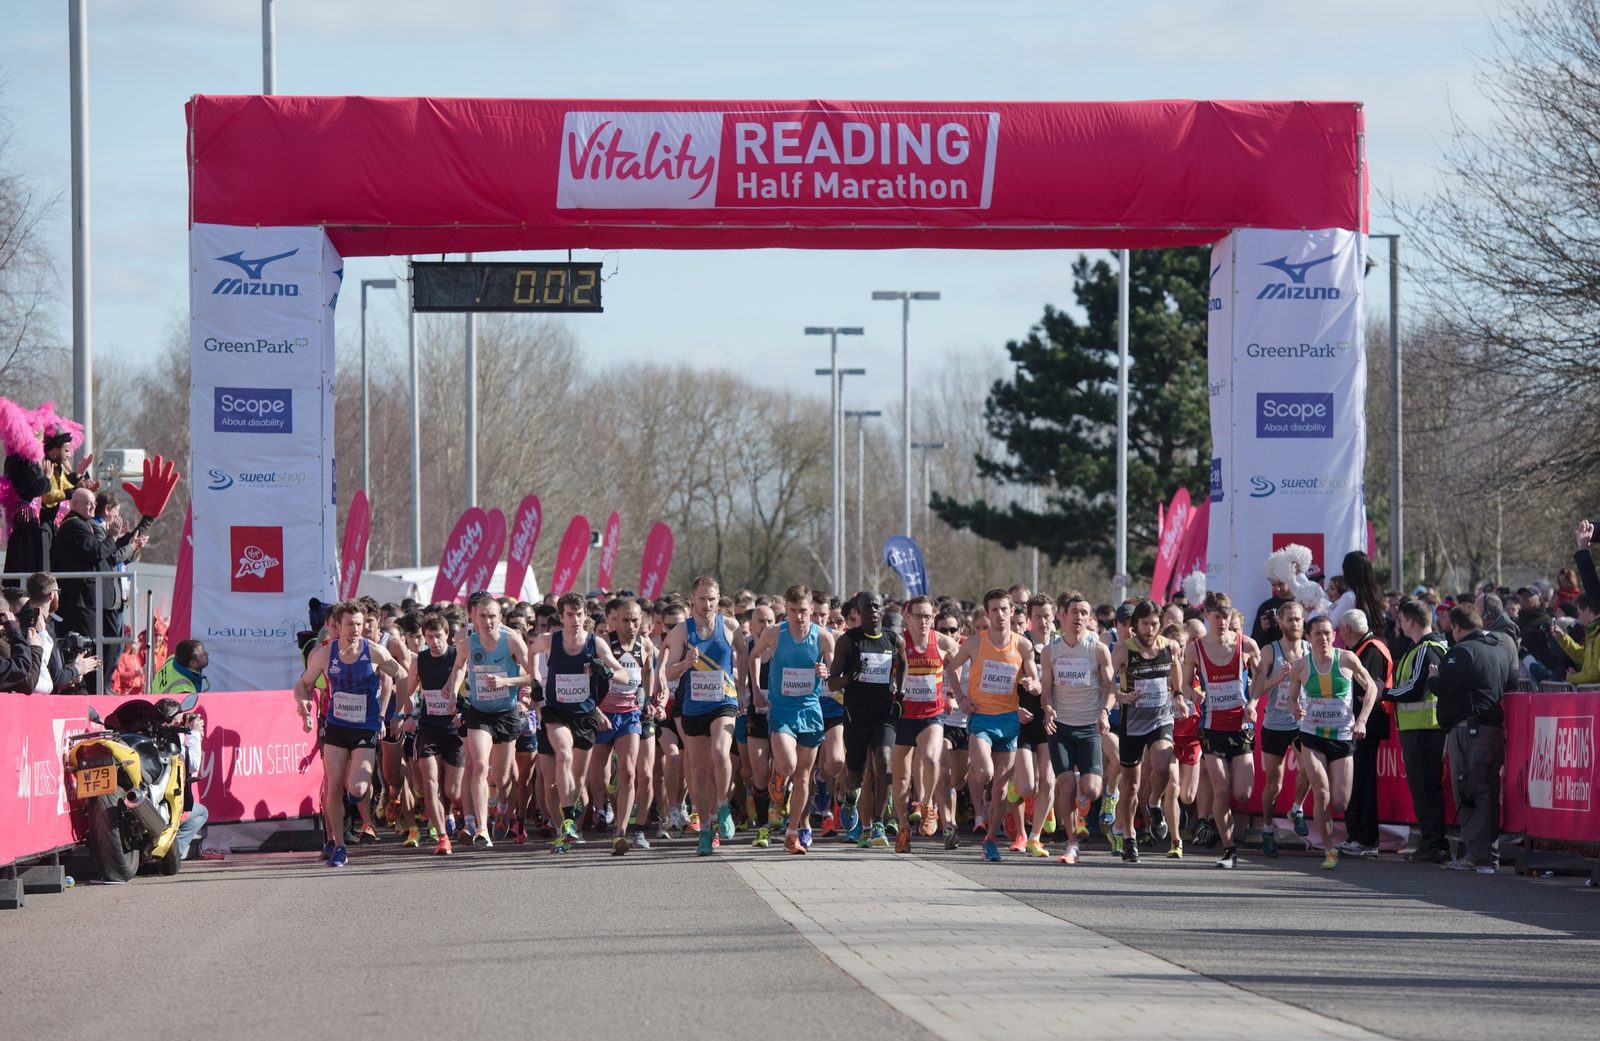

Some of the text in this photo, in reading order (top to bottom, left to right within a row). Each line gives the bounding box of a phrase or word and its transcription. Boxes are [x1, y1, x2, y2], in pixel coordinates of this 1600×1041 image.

[736, 121, 970, 165] READING
[568, 120, 715, 200] Vitality
[737, 171, 968, 200] Half Marathon
[211, 278, 299, 297] MIZUNO
[1256, 283, 1341, 300] MIZUNO
[204, 338, 294, 354] GreenPark
[1247, 343, 1336, 358] GreenPark
[221, 394, 285, 417] Scope
[1263, 399, 1327, 422] Scope
[222, 417, 285, 429] About disability
[1264, 423, 1326, 433] About disability
[239, 471, 306, 484] sweatshop
[1280, 476, 1346, 490] sweatshop
[511, 506, 538, 562] Vitality
[1161, 502, 1187, 561] Vitality
[443, 520, 483, 580] Vitality
[238, 559, 278, 575] ACTIVE
[207, 627, 287, 638] Laureus
[907, 658, 941, 666] ERPENTINE
[865, 667, 888, 676] YEREME
[988, 674, 1012, 683] BEATTIE
[1057, 671, 1087, 679] MURRAY
[557, 687, 586, 696] POLLOCK
[692, 682, 720, 691] CRAGG
[783, 680, 811, 689] HAWKINS
[1210, 693, 1239, 703] THORNE
[334, 702, 363, 712] LAMBERT
[1312, 710, 1342, 718] LIVESEY
[1556, 726, 1590, 769] READING
[234, 745, 263, 777] RUN
[265, 743, 311, 775] SERIES
[1376, 747, 1397, 777] UN
[83, 767, 110, 782] W79
[83, 780, 110, 793] TFJ
